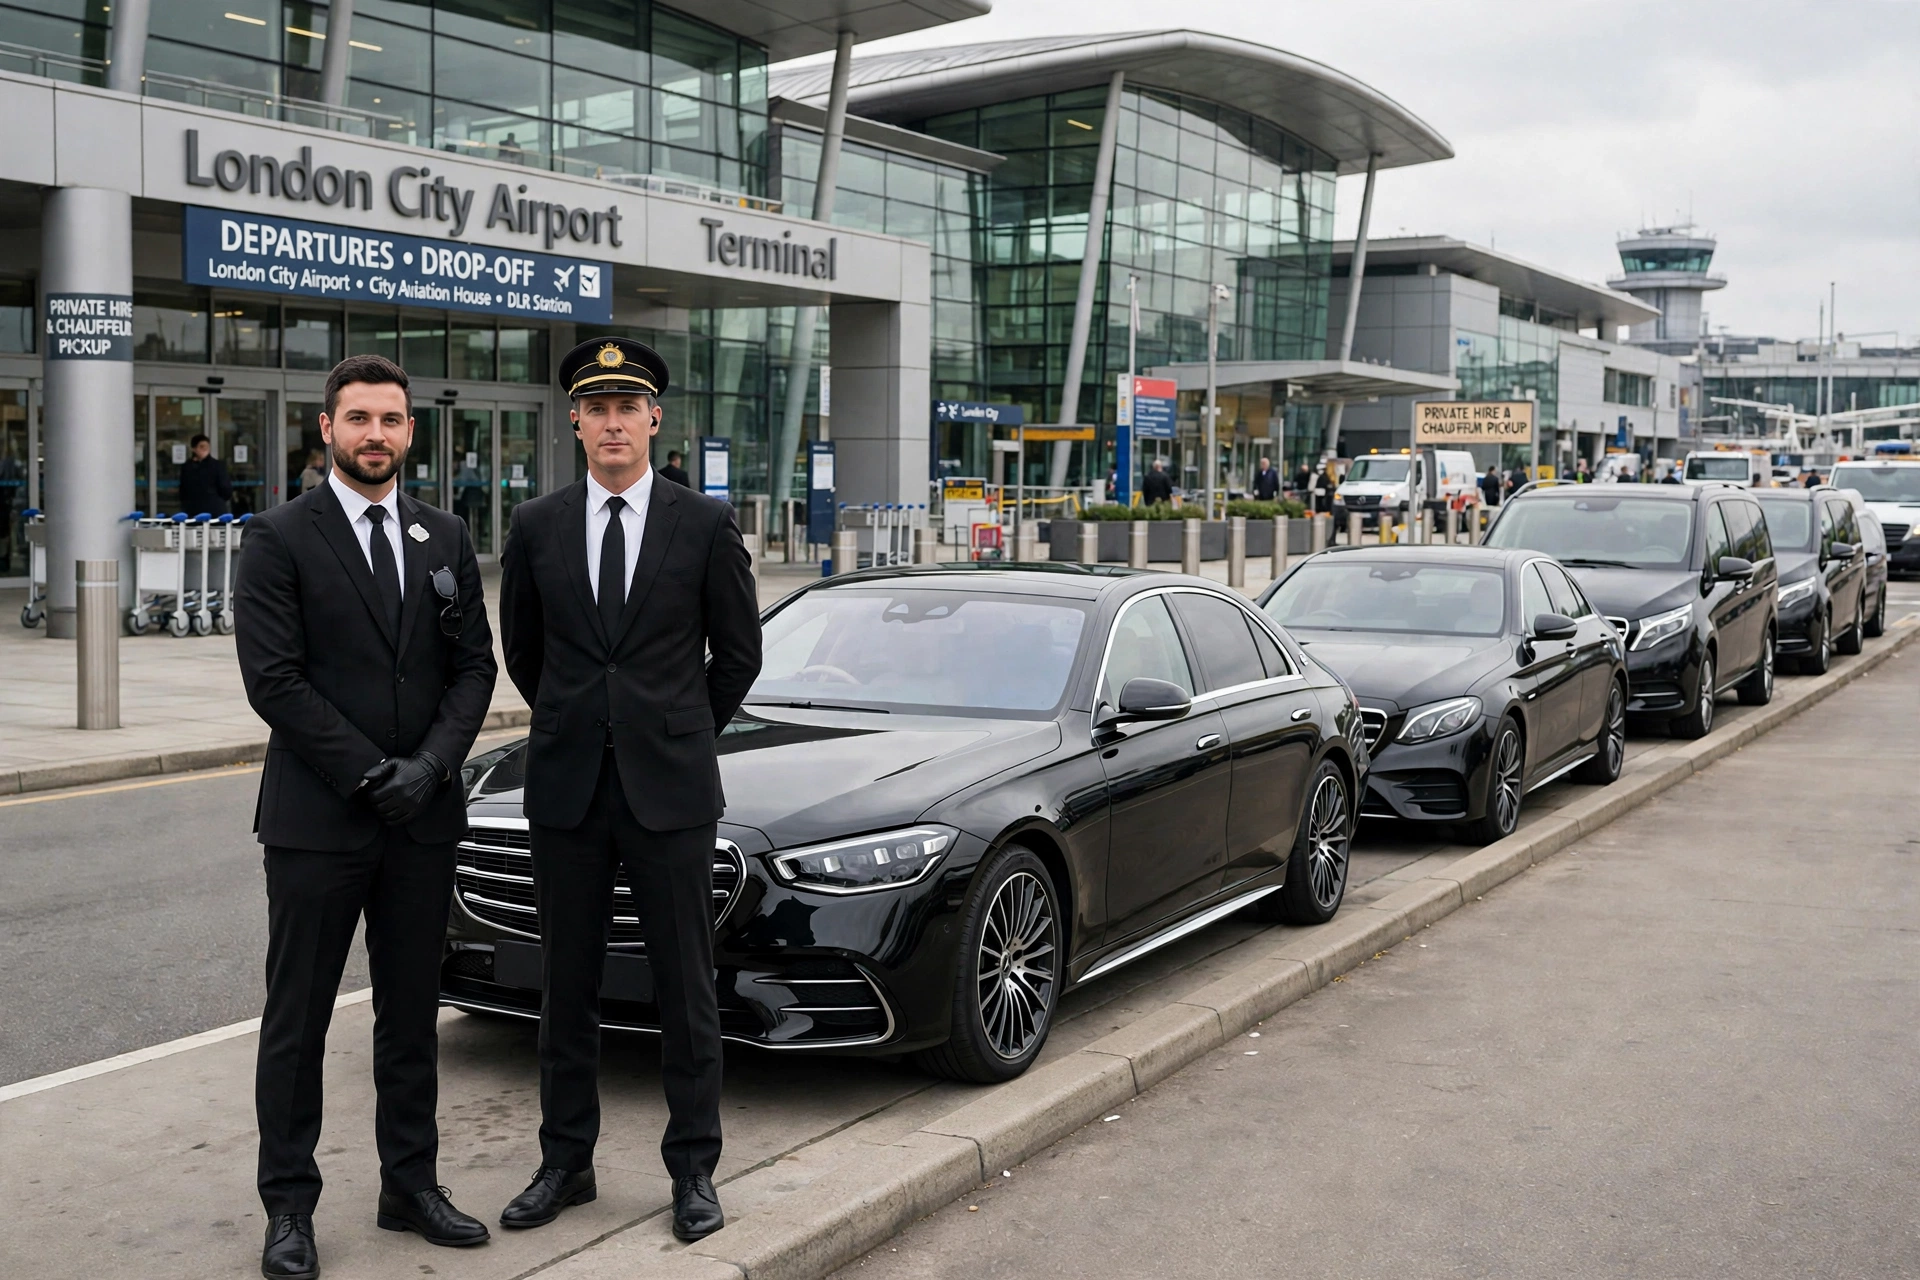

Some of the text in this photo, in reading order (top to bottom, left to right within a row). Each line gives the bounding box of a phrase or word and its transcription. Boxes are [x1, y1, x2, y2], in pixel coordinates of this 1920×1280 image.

[186, 128, 837, 281] London City Airport Terminal
[221, 219, 535, 286] DEPARTURES DROP-OFF
[208, 257, 573, 314] London City Airport City Aviation House DLR Station
[50, 299, 106, 316] PRIVATE
[58, 338, 112, 355] PICKUP
[1473, 406, 1500, 420] HIRE
